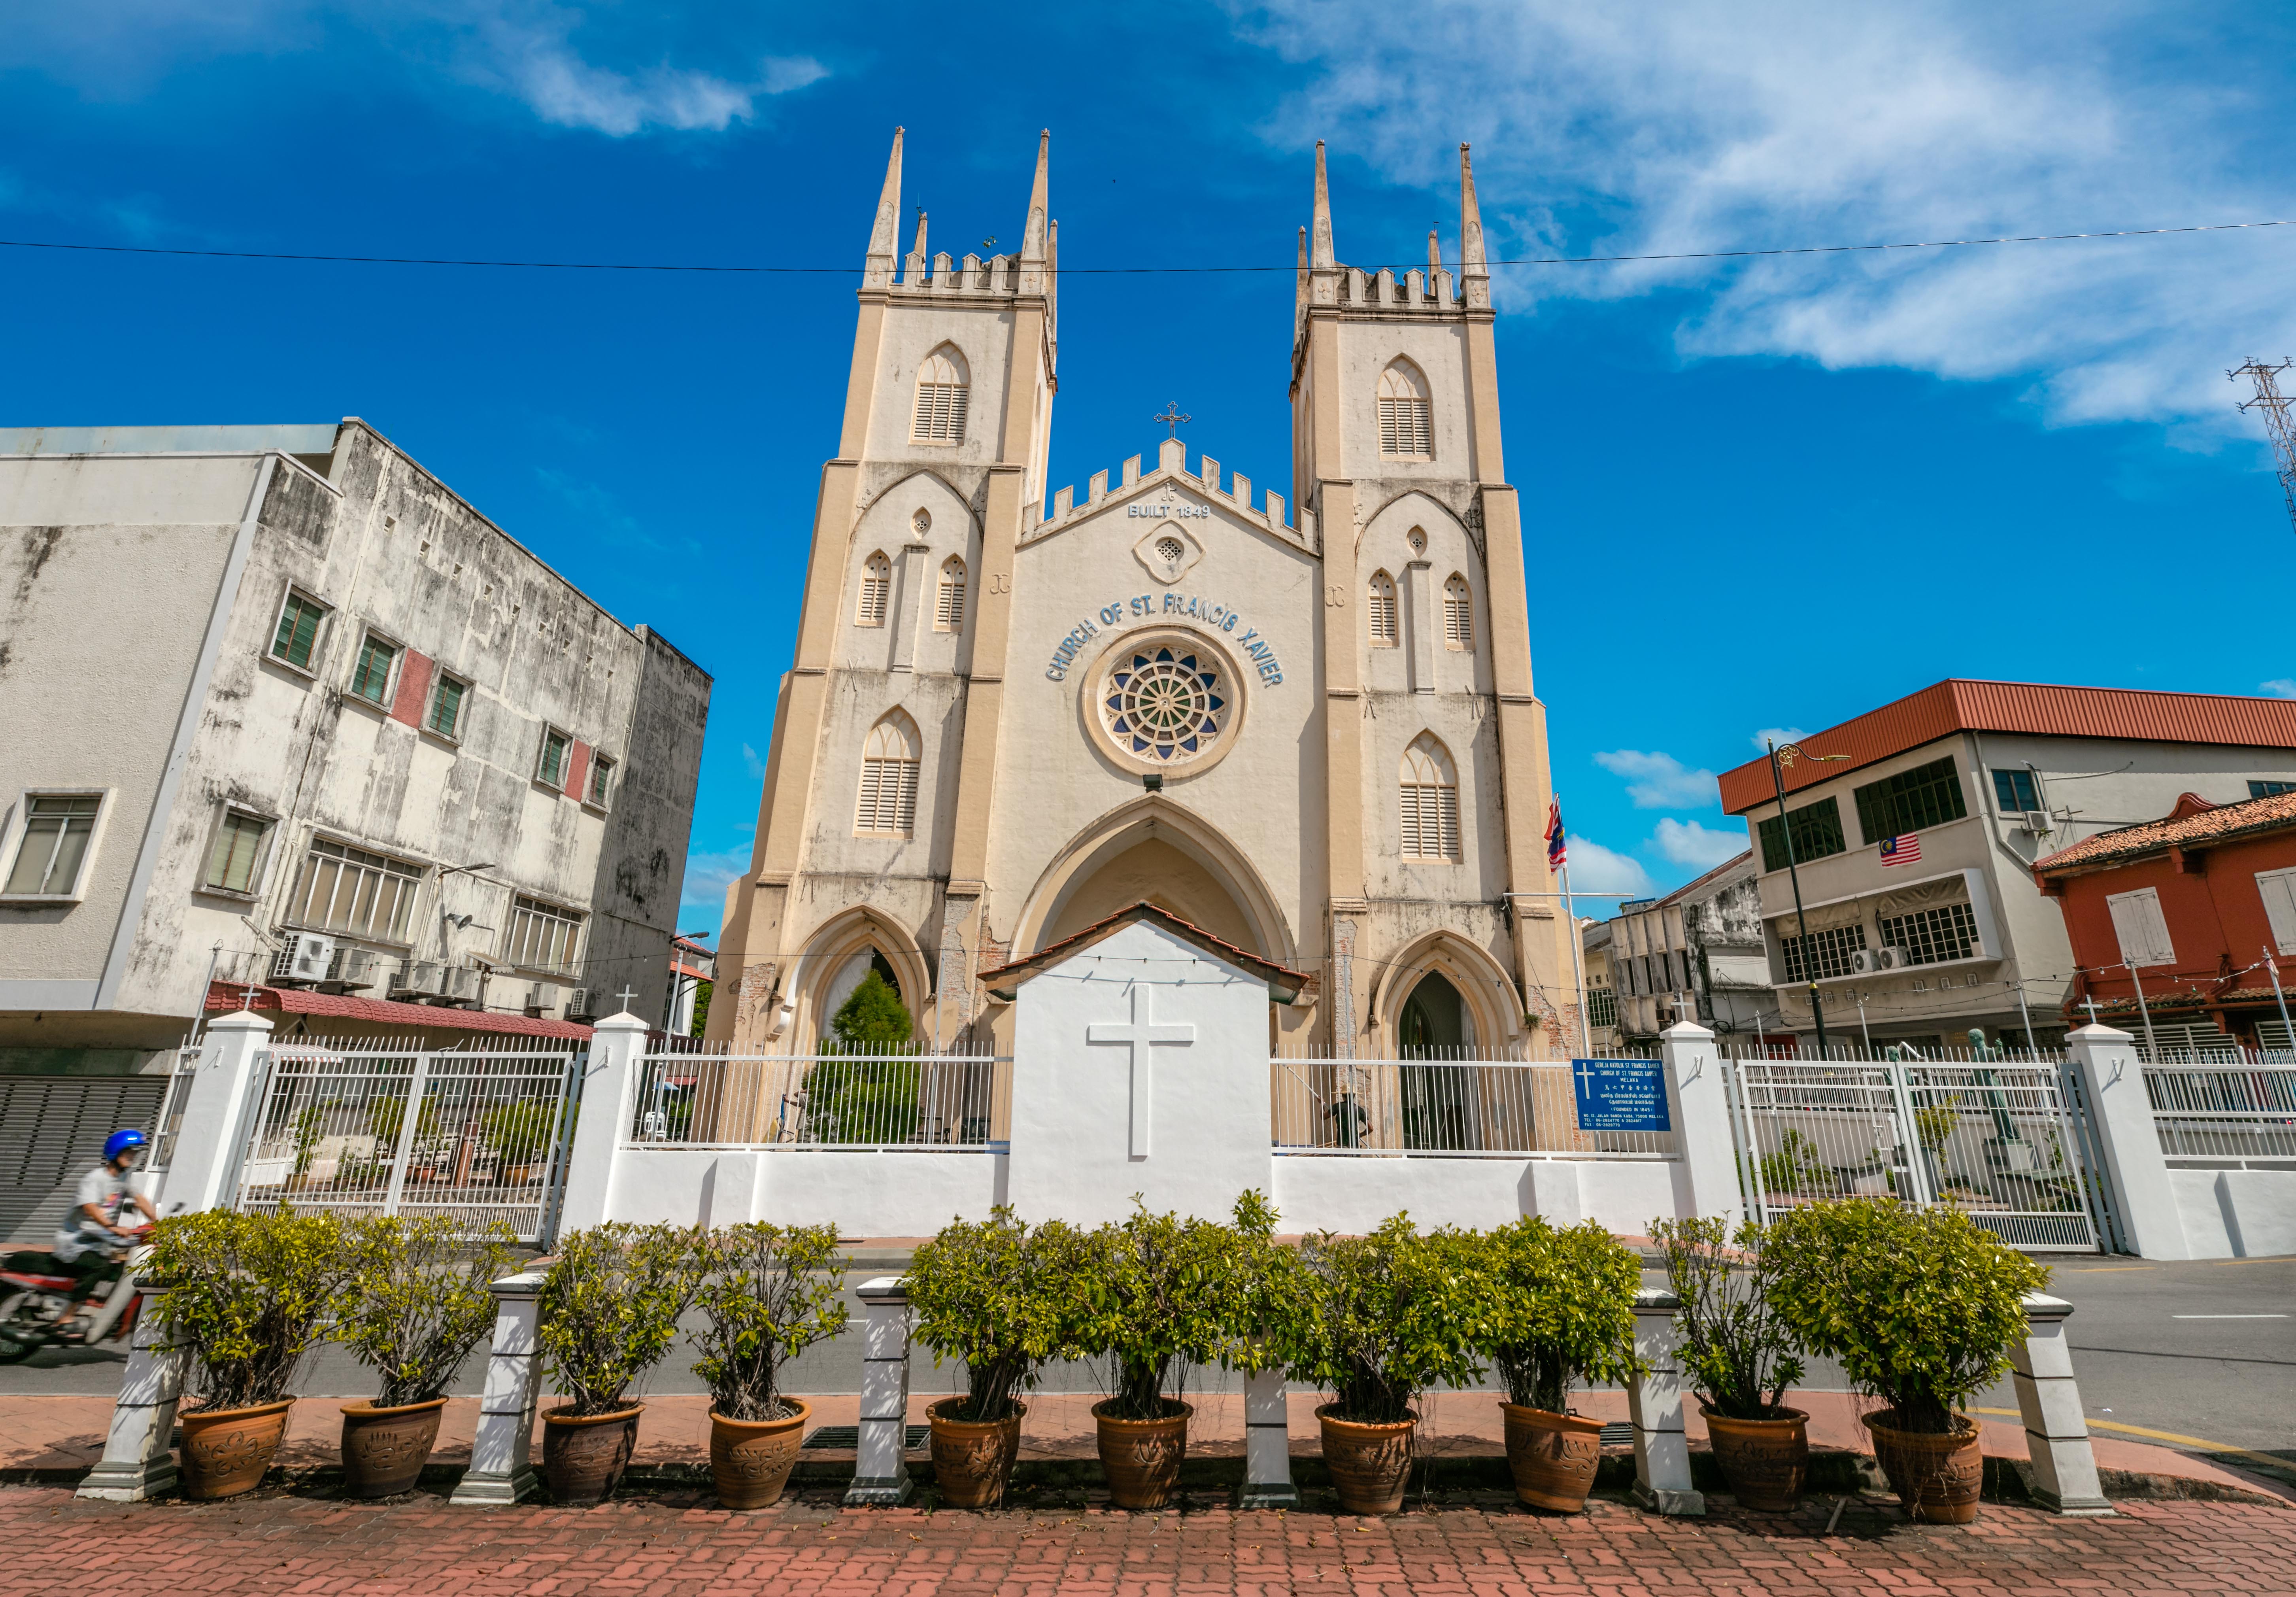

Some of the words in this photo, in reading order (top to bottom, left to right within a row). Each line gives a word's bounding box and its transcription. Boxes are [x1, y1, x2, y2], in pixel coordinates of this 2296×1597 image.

[1129, 504, 1170, 518] BUILT
[1177, 505, 1211, 518] 1849
[1046, 618, 1099, 681] CHURCH
[1100, 602, 1123, 625] OF
[1131, 594, 1156, 615] ST.
[1164, 593, 1239, 632] FRANCIS
[1237, 627, 1284, 688] XAVIER
